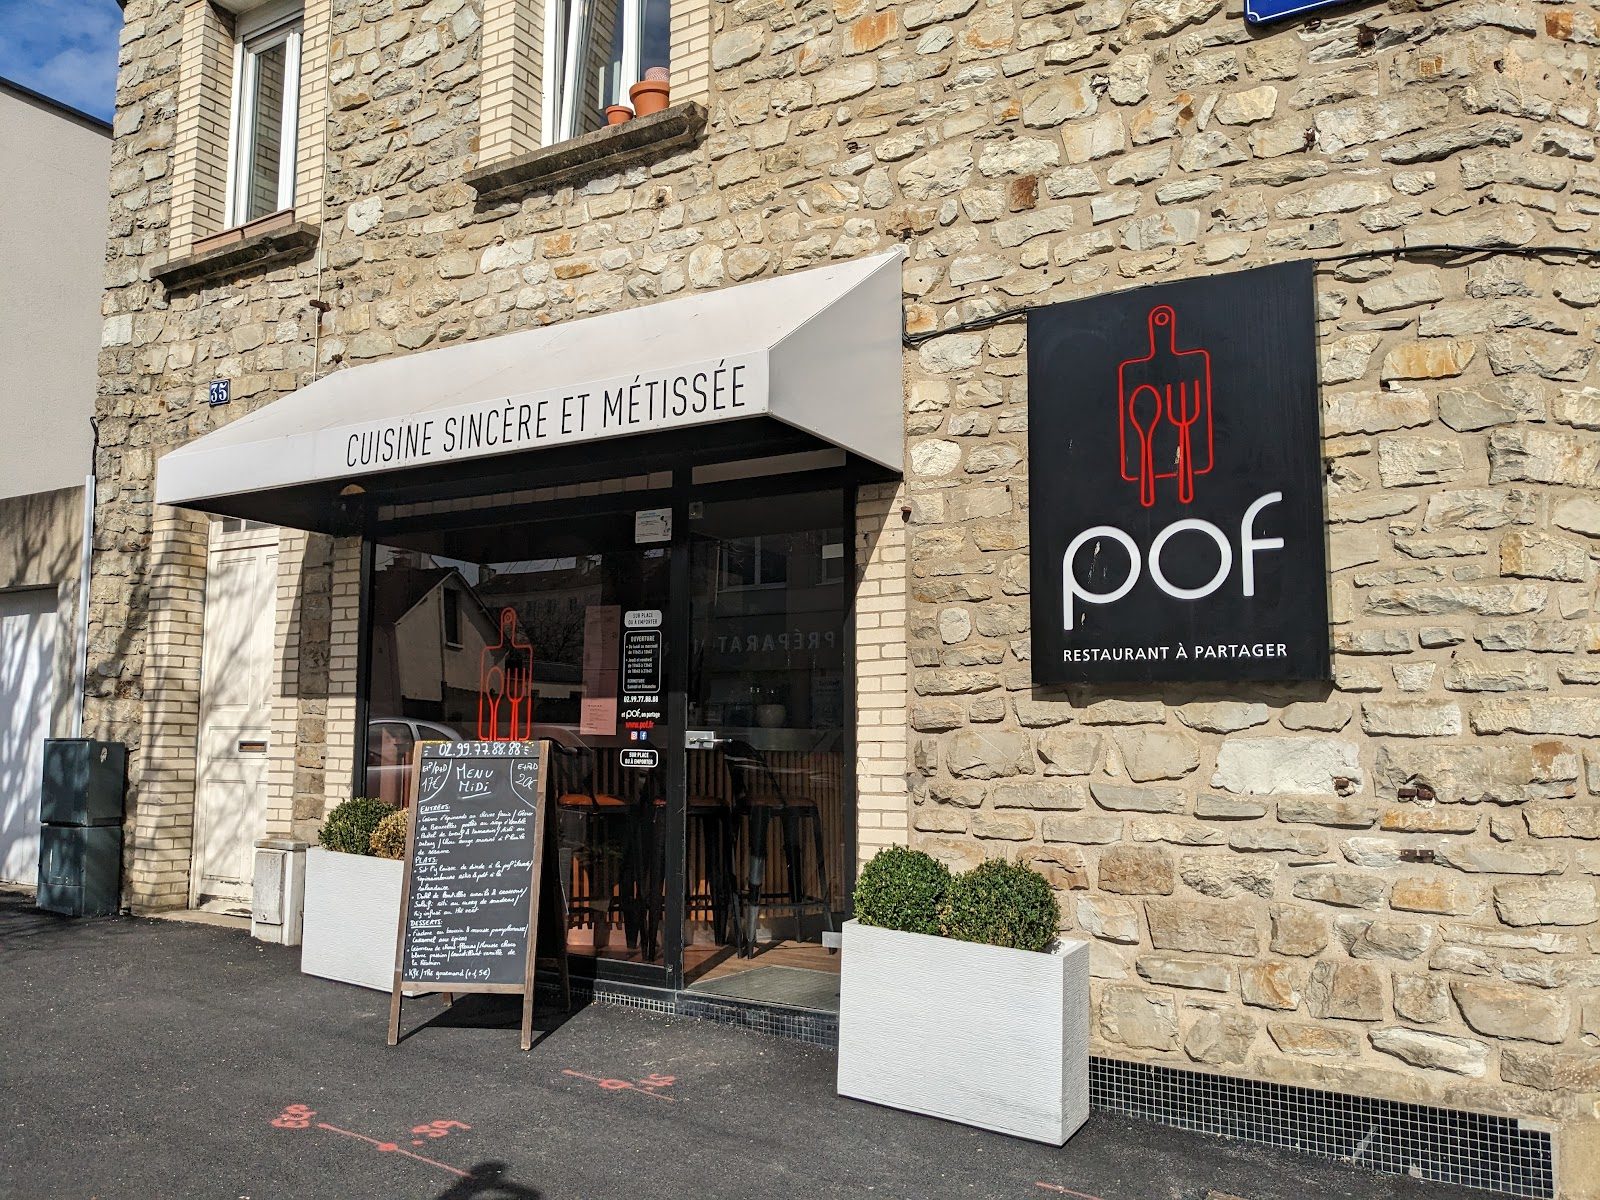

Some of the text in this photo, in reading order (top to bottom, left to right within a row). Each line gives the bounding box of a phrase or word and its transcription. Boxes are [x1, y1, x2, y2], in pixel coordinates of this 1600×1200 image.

[211, 382, 228, 402] 35
[346, 359, 747, 467] CUISINE SINCÈRE ET MÉTISSÉE
[1063, 491, 1285, 631] pof
[1063, 643, 1287, 662] RESTAURANT À PARTAGER
